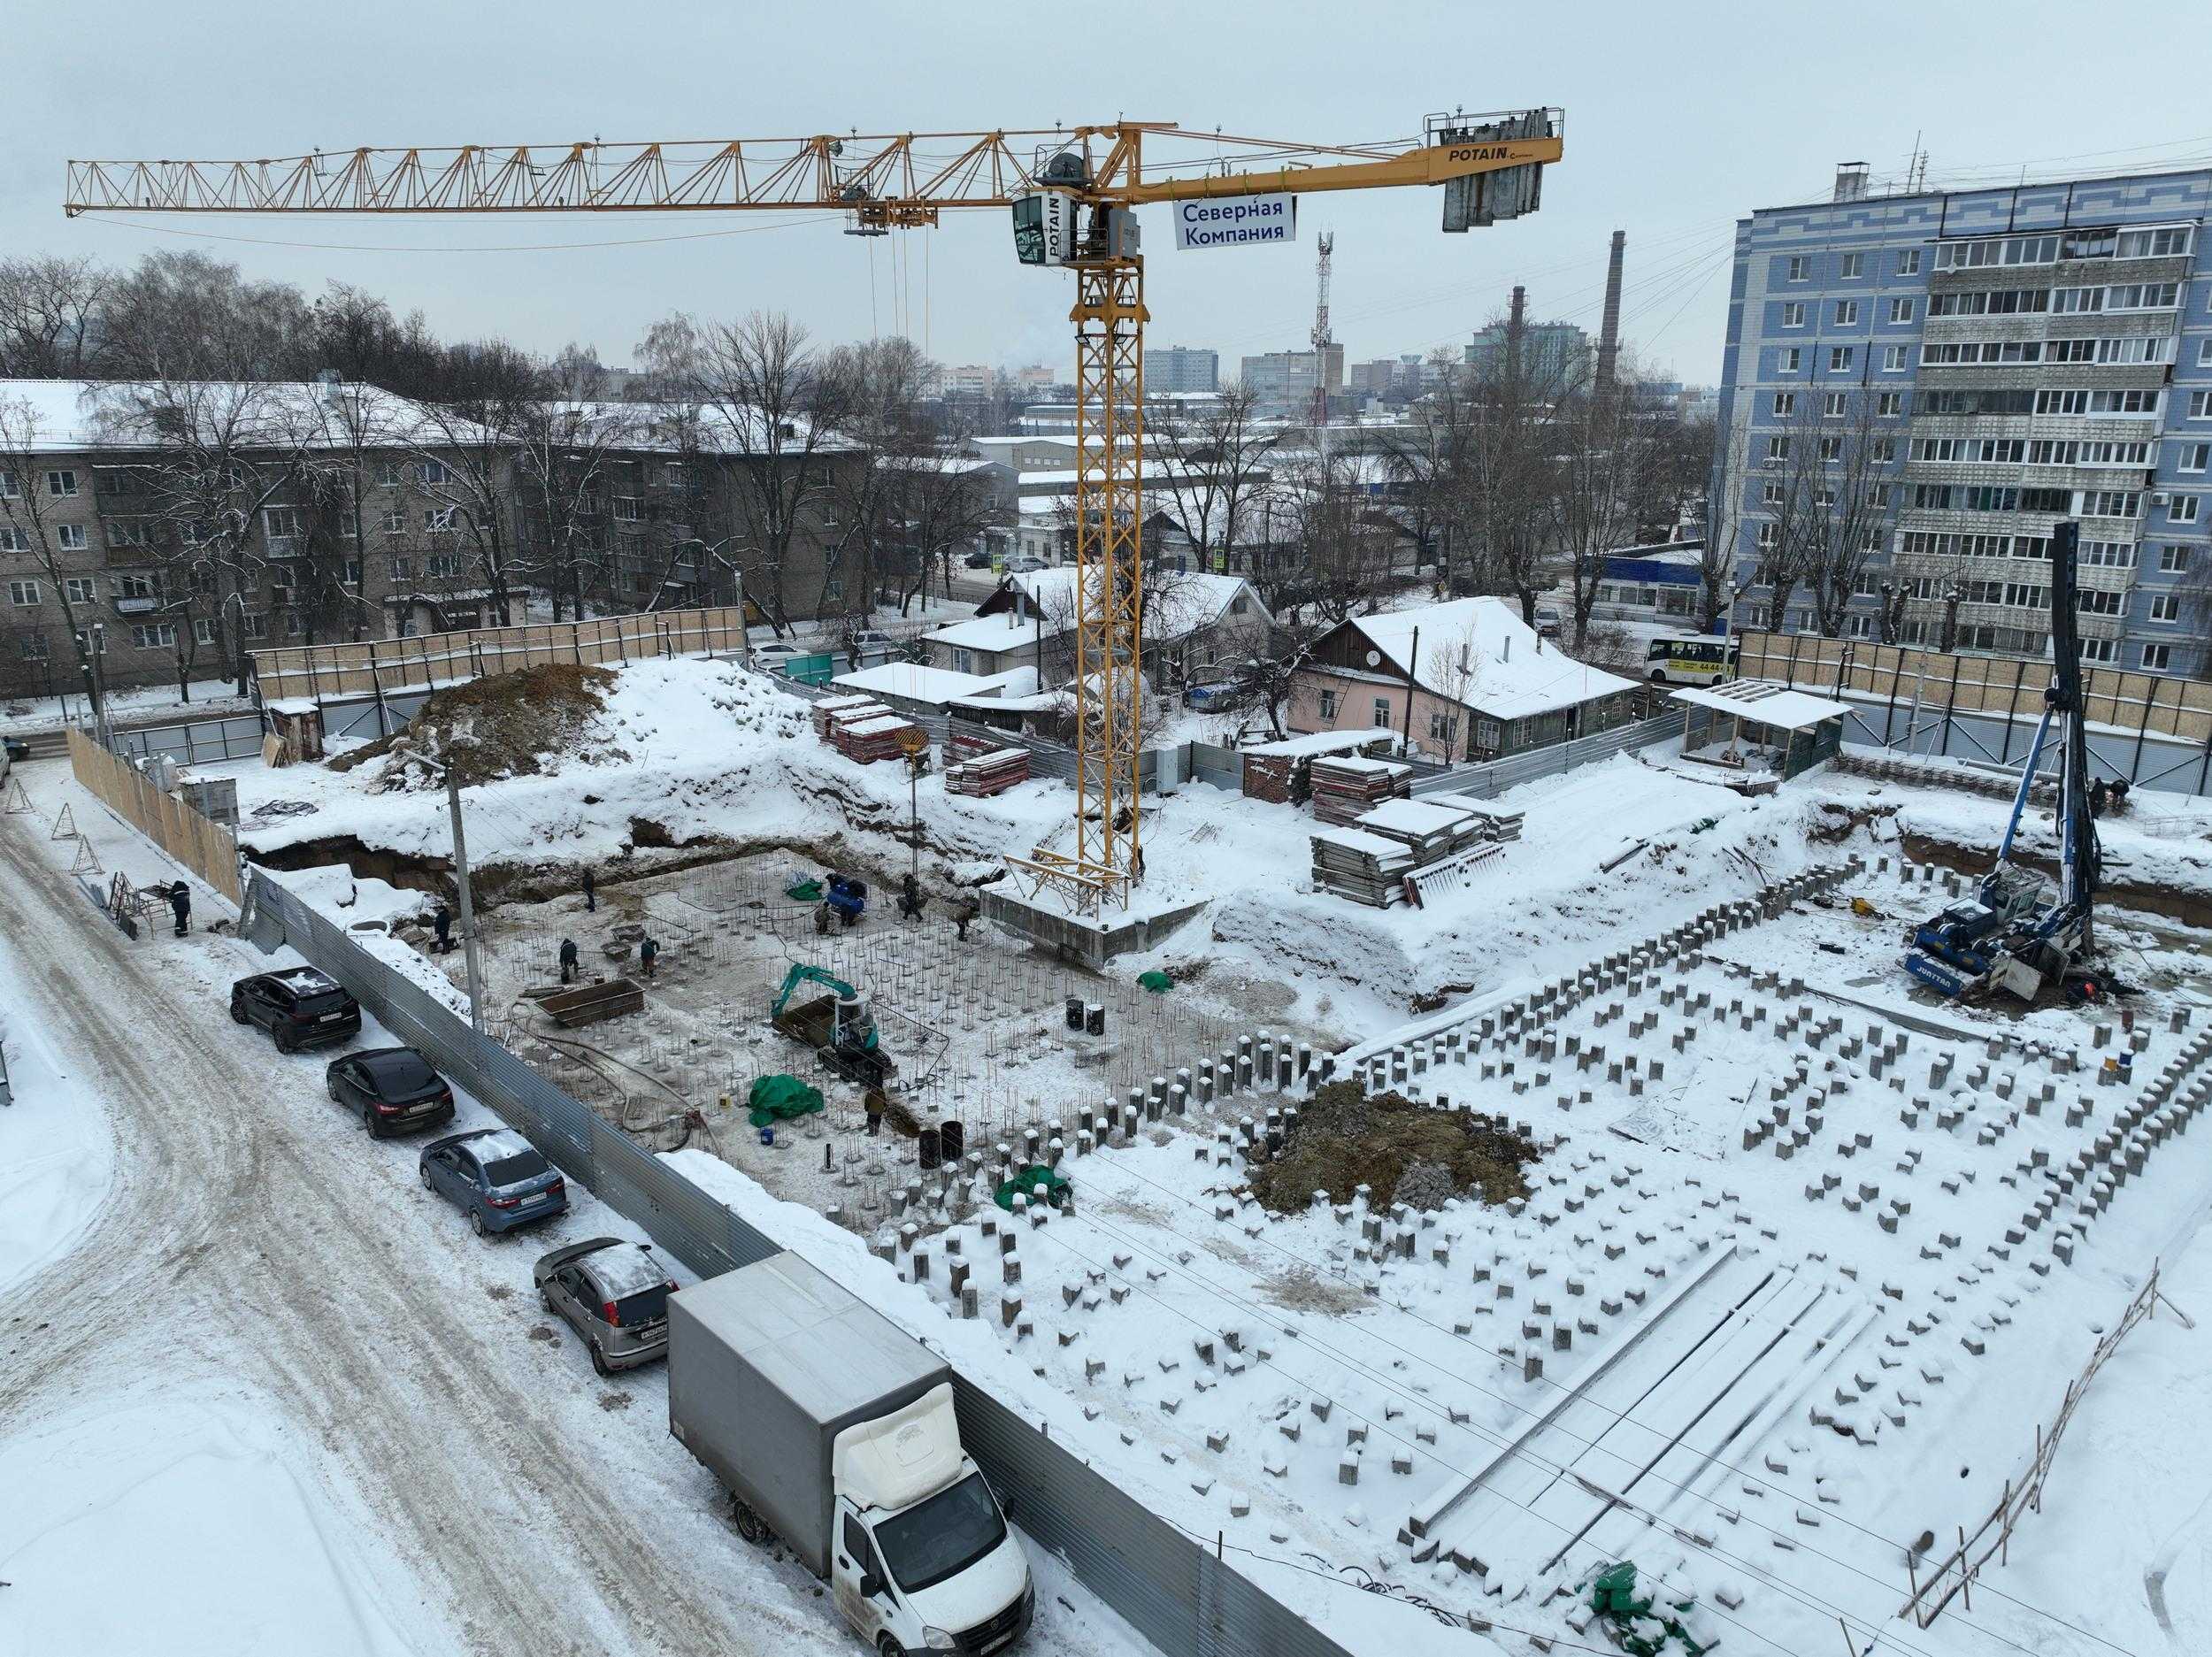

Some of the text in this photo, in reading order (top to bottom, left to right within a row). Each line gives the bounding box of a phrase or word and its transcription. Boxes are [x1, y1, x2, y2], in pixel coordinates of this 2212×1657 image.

[1449, 148, 1508, 162] POTAIN
[1183, 202, 1283, 223] Северная
[1048, 197, 1060, 257] POTAIN
[1185, 226, 1284, 246] Компания
